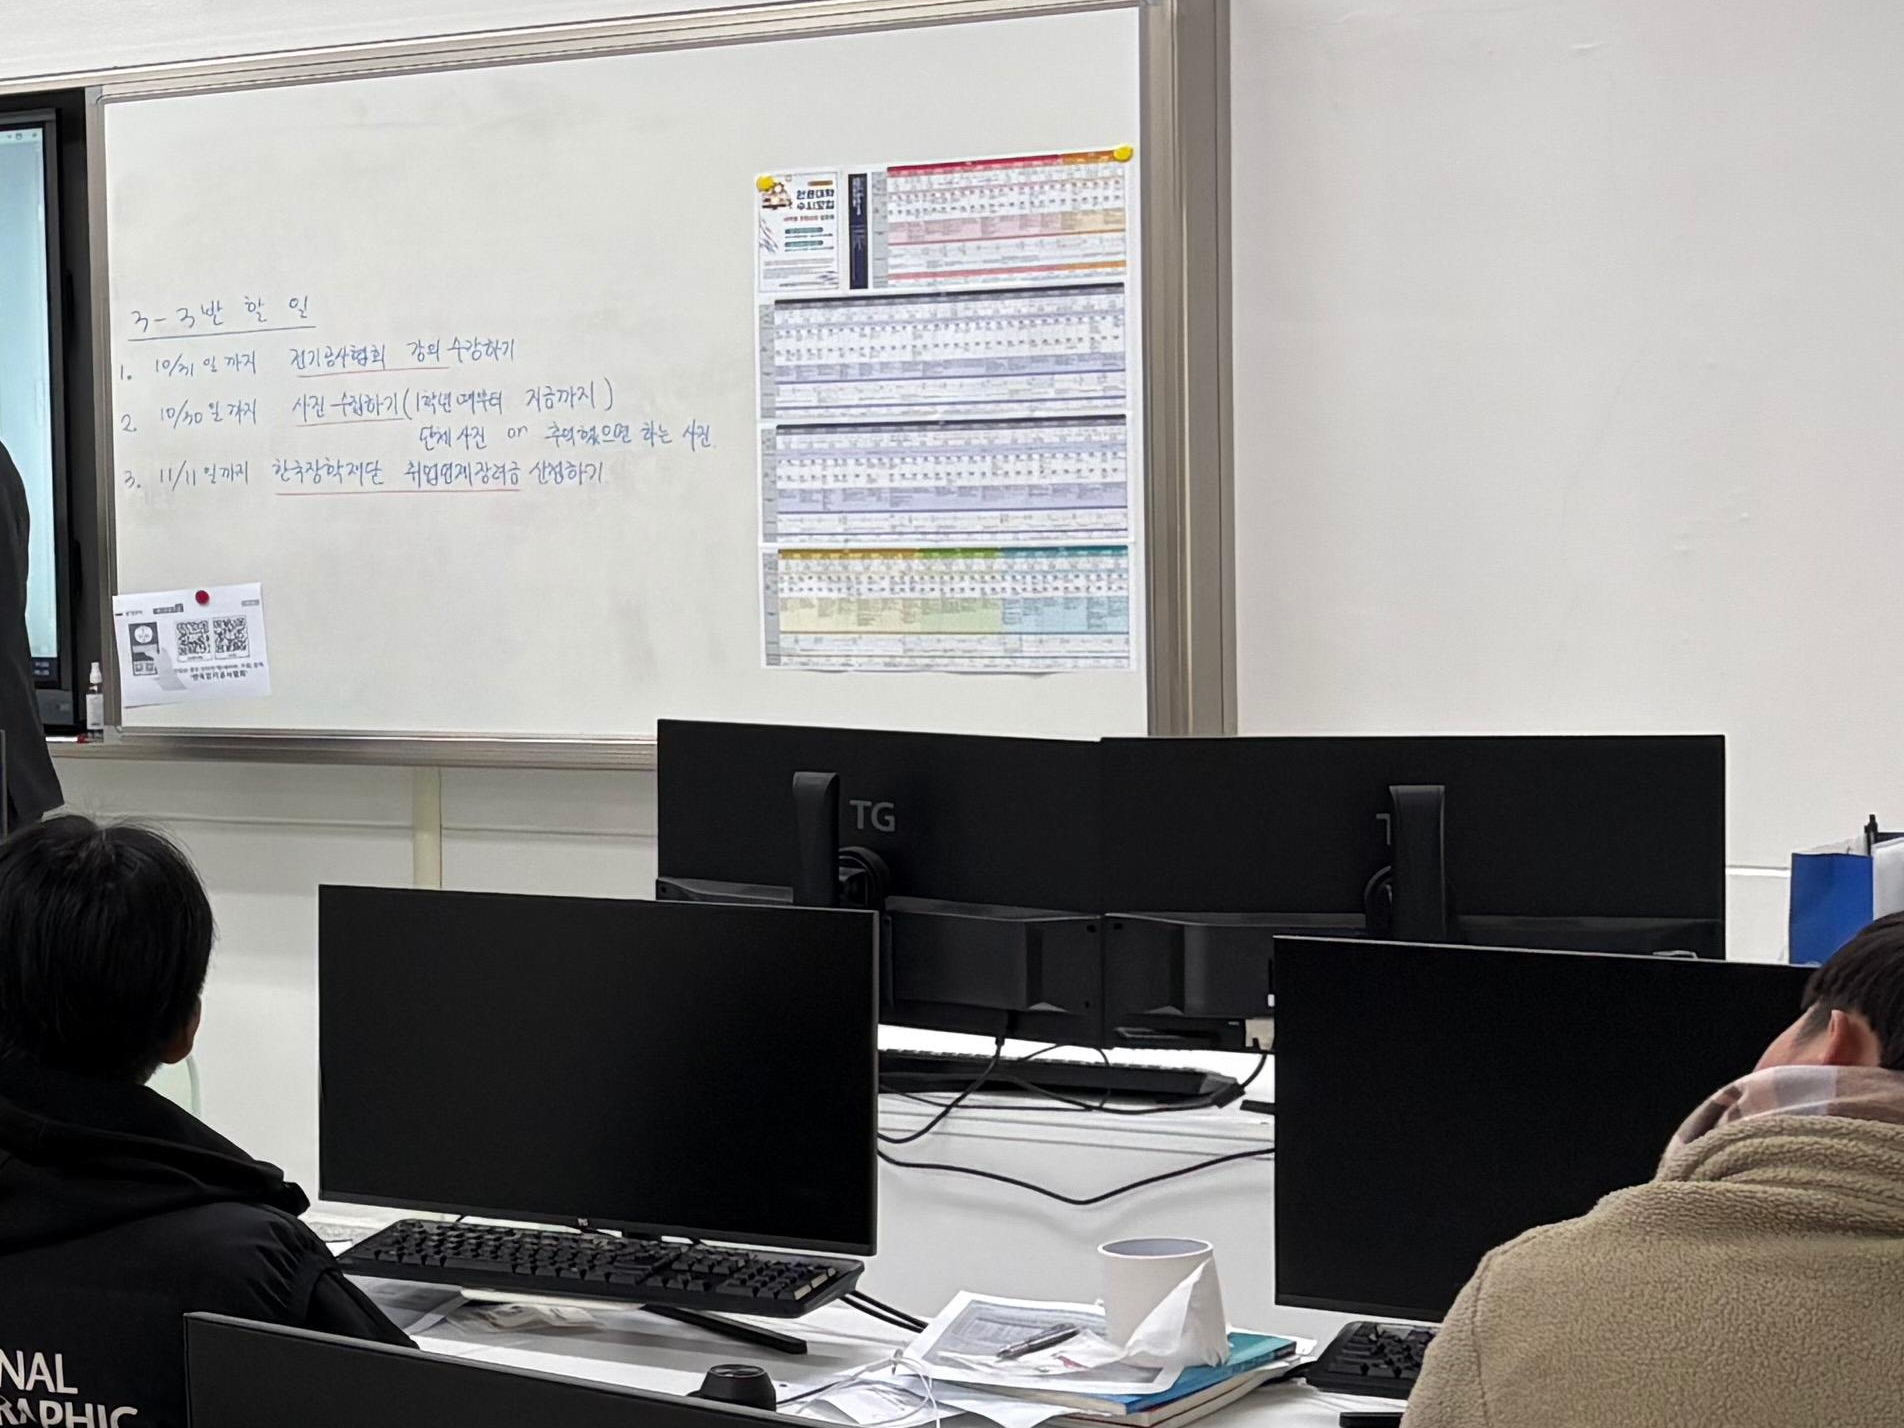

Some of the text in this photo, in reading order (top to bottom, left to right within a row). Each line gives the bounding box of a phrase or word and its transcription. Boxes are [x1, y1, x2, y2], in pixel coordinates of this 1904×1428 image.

[244, 296, 267, 323] 할
[288, 294, 309, 319] 일
[290, 345, 386, 370] 전기공사협회
[407, 338, 440, 362] 강의
[447, 337, 515, 363] 수강하기
[292, 395, 325, 422] 사진
[456, 424, 488, 450] 사진
[507, 424, 529, 439] or
[641, 420, 673, 448] 하는
[272, 458, 384, 486] 한국장학재단
[849, 800, 895, 831] TG
